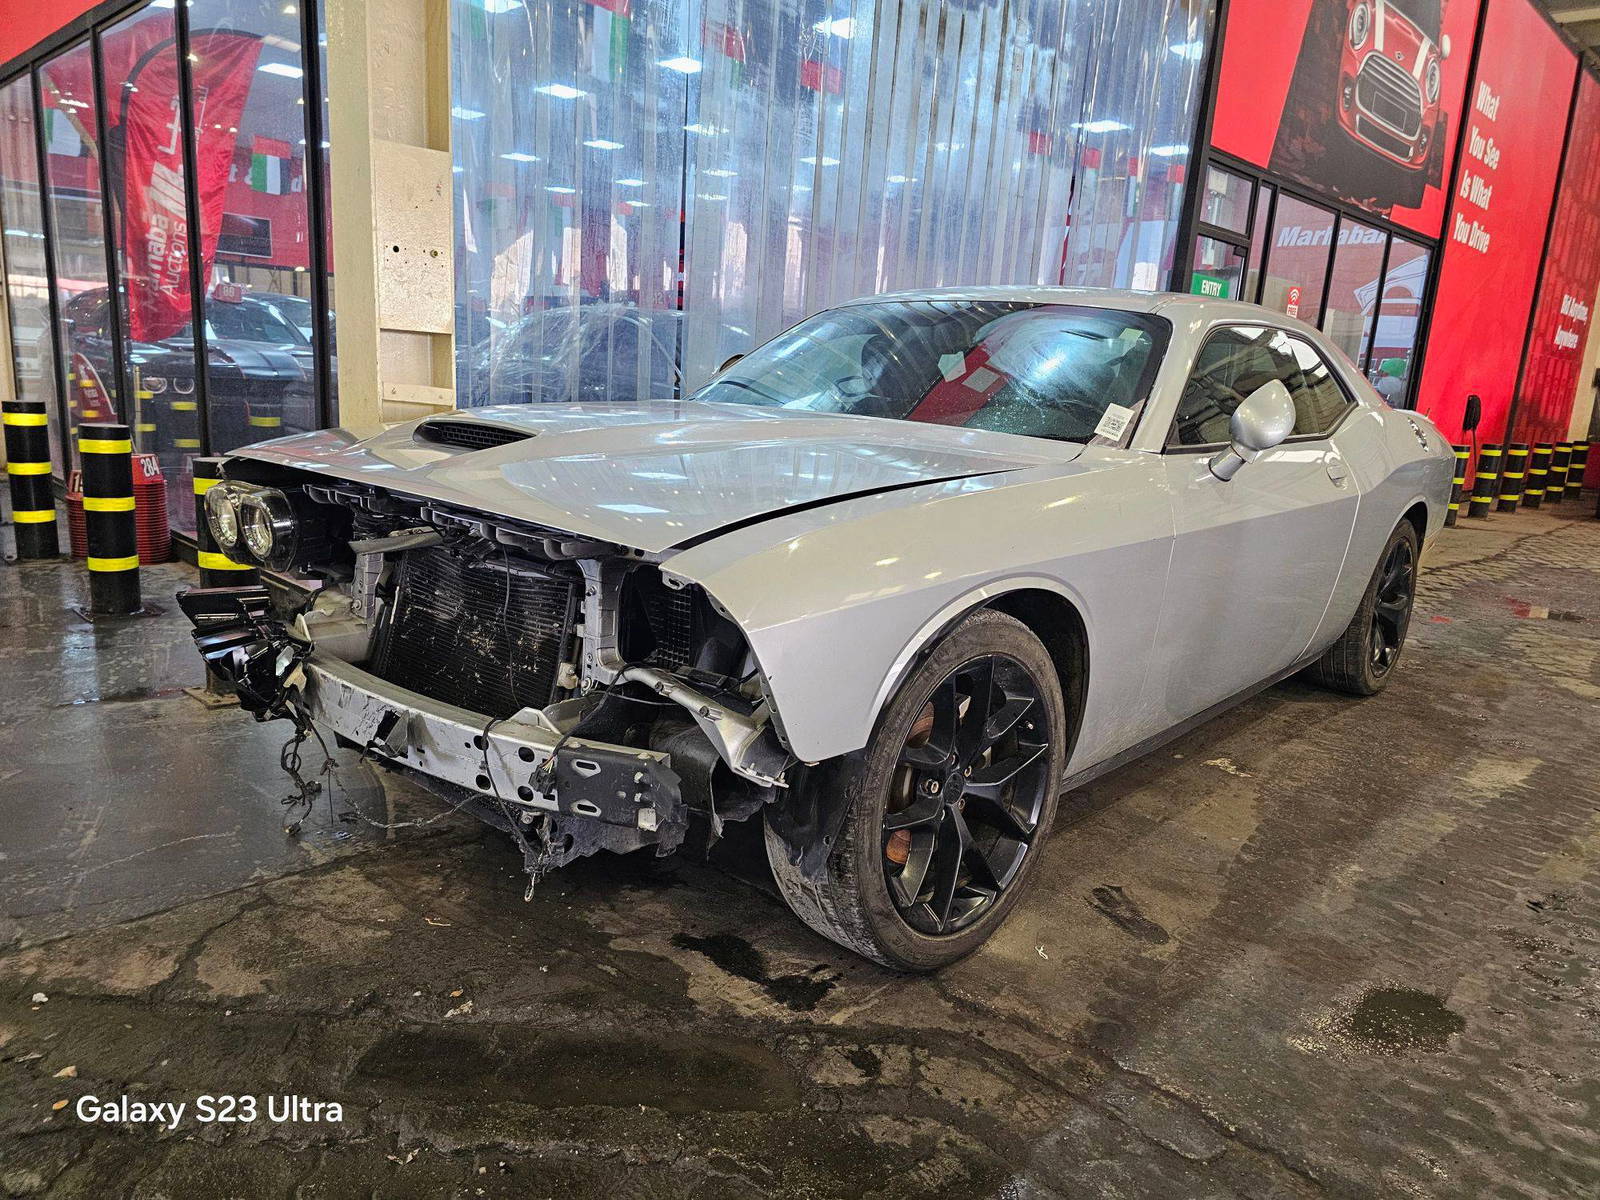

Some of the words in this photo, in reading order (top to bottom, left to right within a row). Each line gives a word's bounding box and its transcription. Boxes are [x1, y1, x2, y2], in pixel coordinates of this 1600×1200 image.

[1476, 80, 1500, 122] What
[1468, 125, 1485, 161] You
[1484, 138, 1500, 170] See
[1460, 169, 1471, 199] Is
[1469, 174, 1493, 210] What
[1453, 212, 1471, 244] You
[1468, 220, 1491, 254] Drive
[1201, 279, 1222, 297] ENTRY
[140, 457, 160, 477] 284
